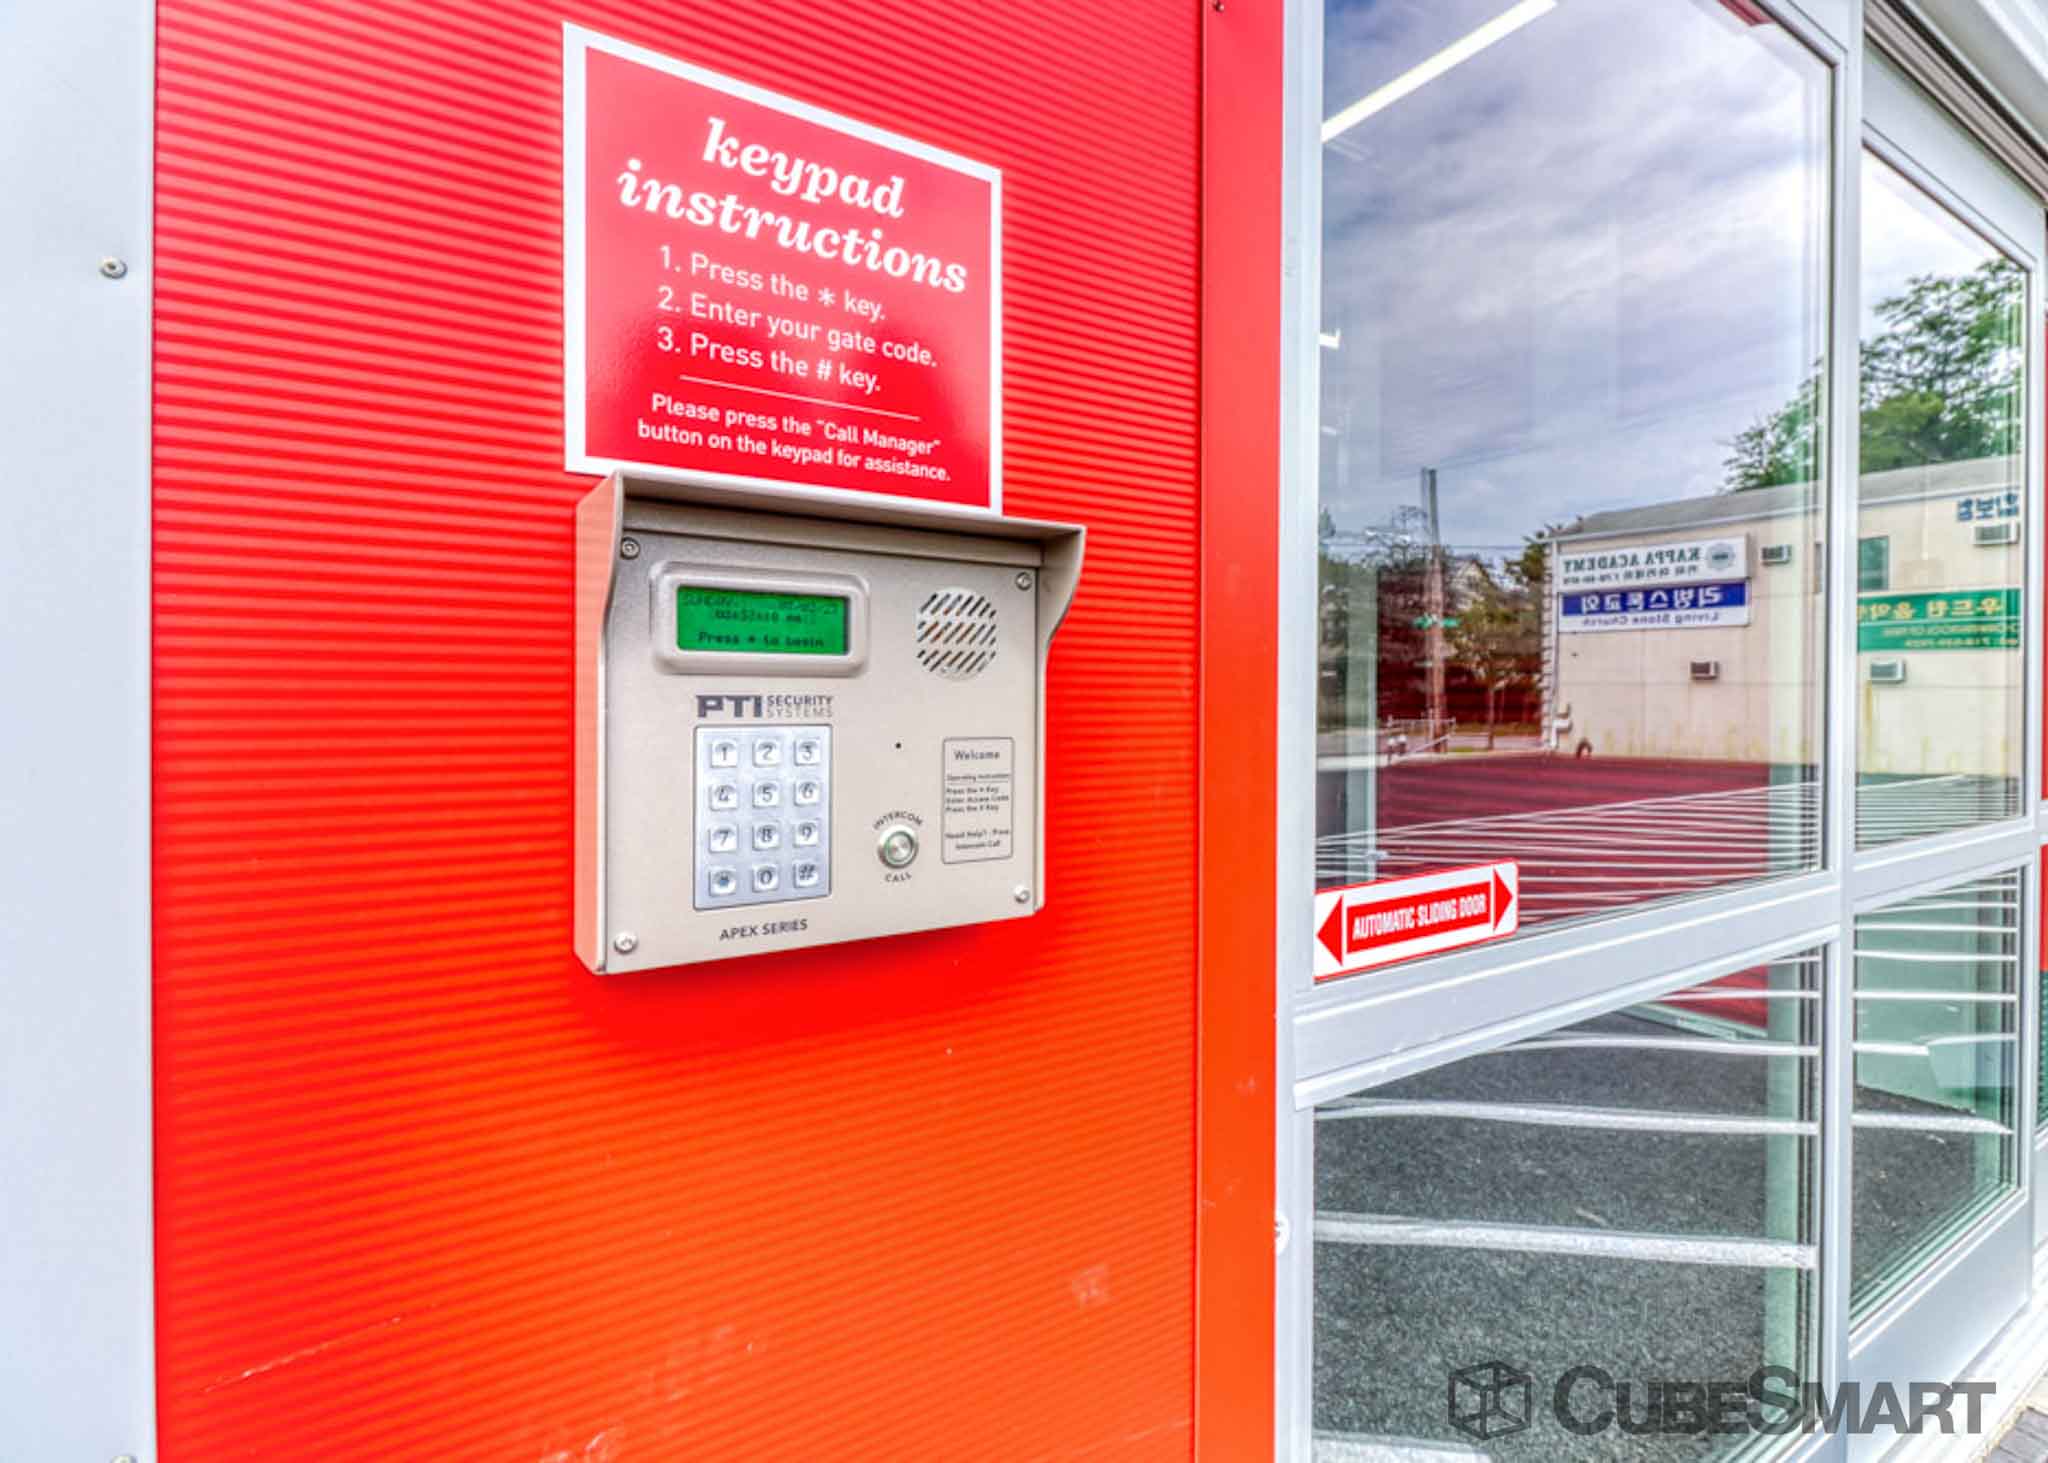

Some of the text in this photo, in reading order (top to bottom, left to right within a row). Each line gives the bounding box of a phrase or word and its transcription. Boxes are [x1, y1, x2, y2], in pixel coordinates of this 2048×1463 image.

[702, 117, 905, 219] keypad
[617, 158, 968, 293] instructions
[660, 246, 681, 272] 1.
[691, 253, 763, 291] Press
[771, 272, 808, 302] the
[844, 292, 886, 321] key.
[657, 286, 938, 367] 2. Enter your gate code.
[657, 326, 881, 392] 3. Press the # key.
[651, 393, 720, 423] Please
[725, 411, 778, 435] press
[782, 414, 811, 436] the
[638, 418, 951, 482] button on the keypad for assistance.
[698, 631, 740, 645] Press
[696, 695, 763, 718] PTI
[767, 695, 834, 707] SECURITY
[767, 707, 833, 718] SYSTEMS
[953, 749, 1001, 761] Welcome
[872, 810, 923, 831] INTERCOM
[884, 871, 912, 883] CALL
[719, 918, 808, 941] APEX SERIES
[1353, 893, 1487, 940] AUTOMATIC SLIDING DOOR
